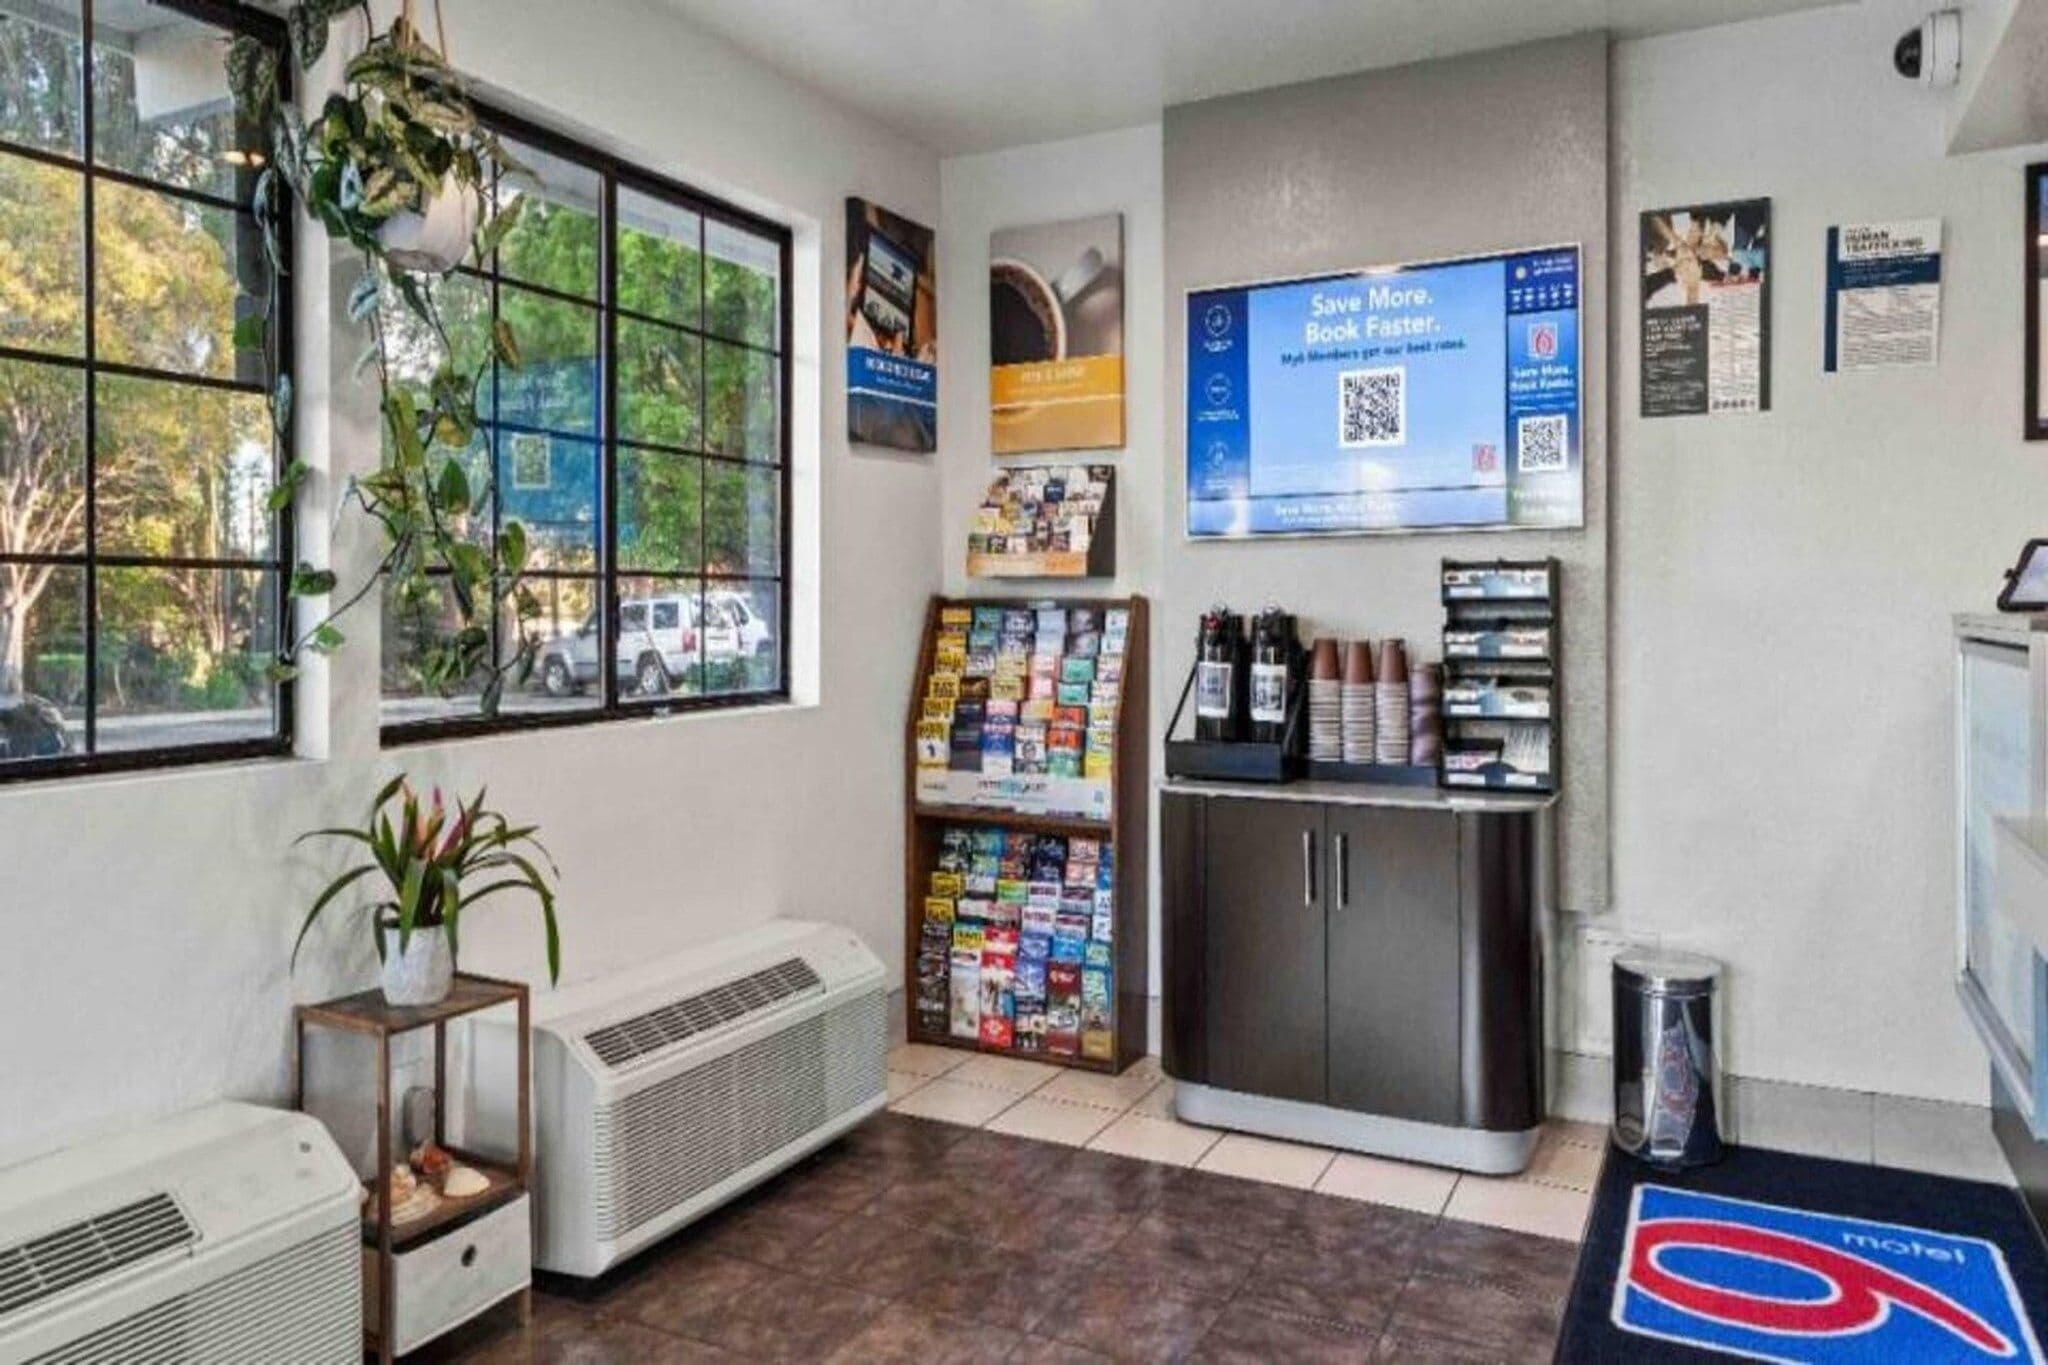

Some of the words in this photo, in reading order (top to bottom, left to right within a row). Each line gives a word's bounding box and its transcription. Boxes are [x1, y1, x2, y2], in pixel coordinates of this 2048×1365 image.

[1845, 228, 1889, 241] HUMAN
[1311, 293, 1362, 317] Save
[1367, 285, 1434, 311] More.
[1305, 318, 1360, 345] Book
[1365, 314, 1442, 338] Faster.
[1307, 347, 1358, 361] Members
[1362, 347, 1380, 360] get
[1406, 341, 1431, 352] best
[1841, 1230, 1965, 1266] motel
